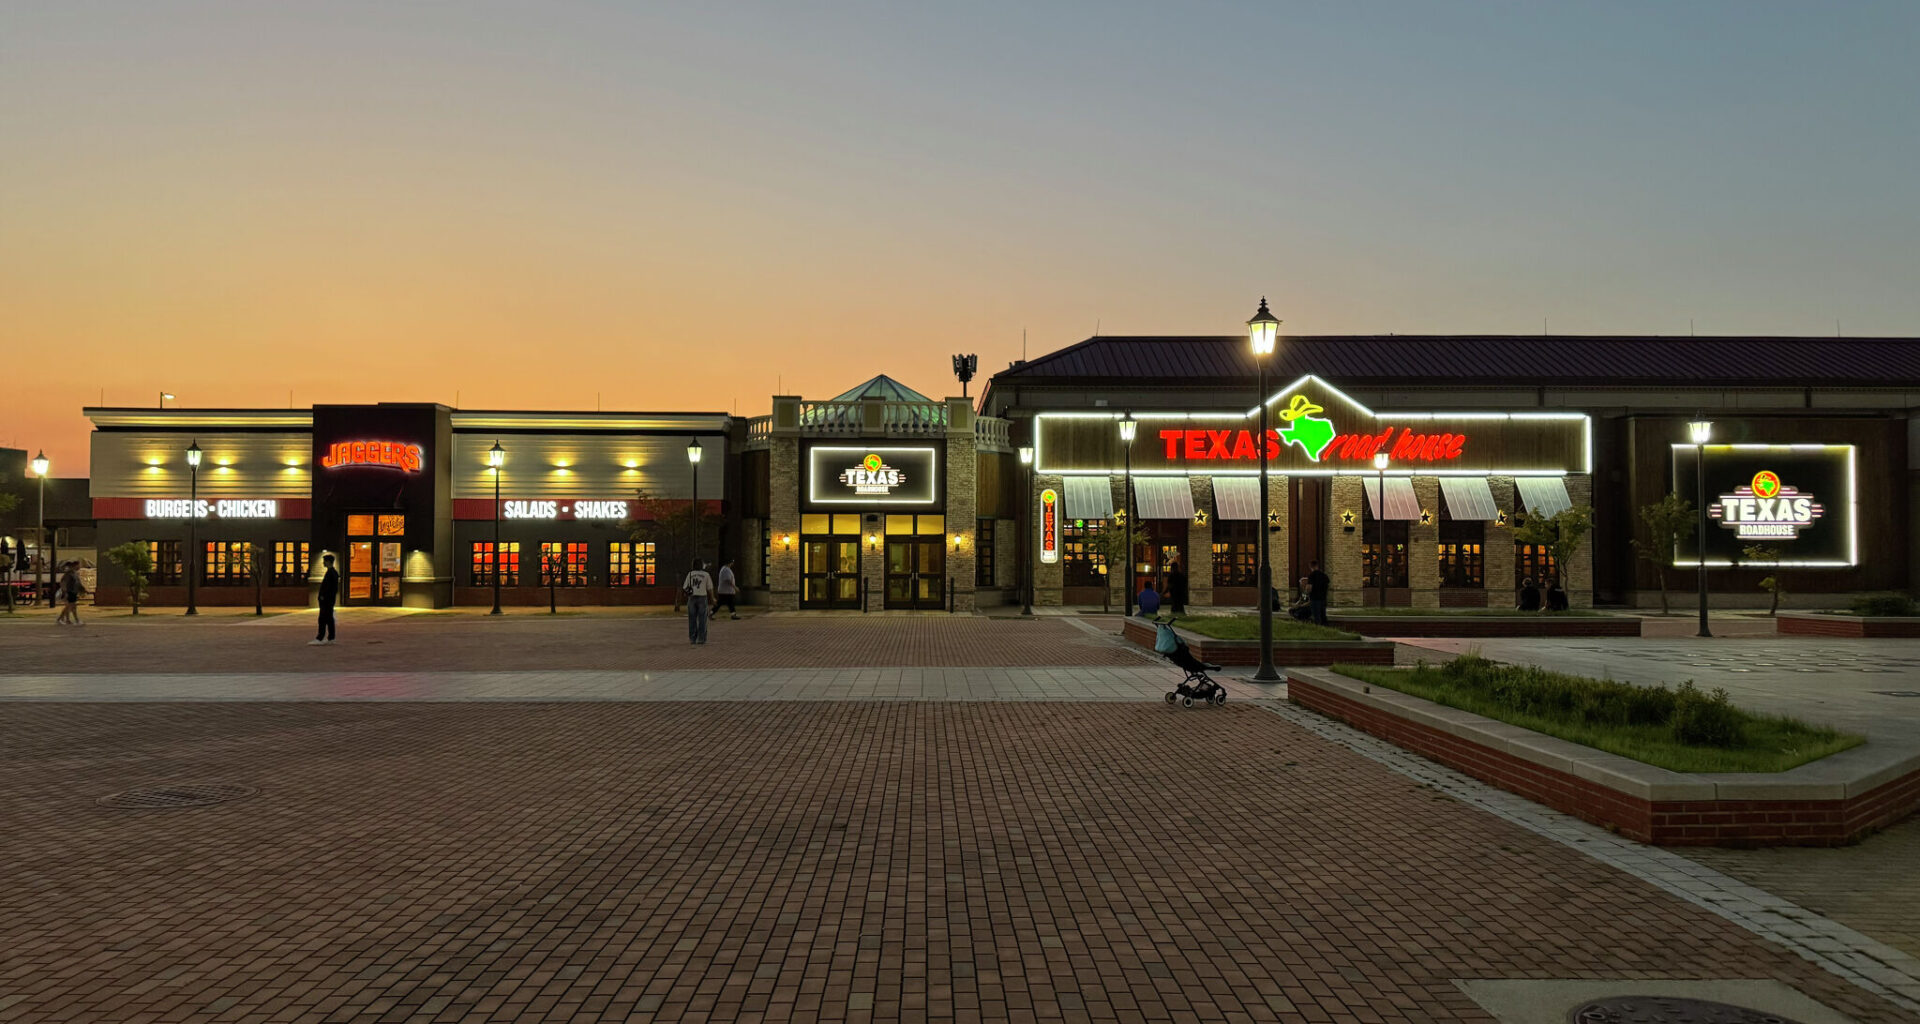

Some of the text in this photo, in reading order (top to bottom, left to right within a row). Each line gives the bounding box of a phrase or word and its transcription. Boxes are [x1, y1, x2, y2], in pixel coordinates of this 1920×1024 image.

[1160, 426, 1466, 462] TEXAS road house
[322, 441, 421, 472] JAGGERS
[845, 470, 899, 485] TEXAS
[146, 500, 276, 517] BURGERS CHICKEN
[504, 501, 627, 518] SALADS SHAKES
[1721, 499, 1811, 521] TEXAS
[1045, 503, 1054, 551] TEXAS
[1739, 525, 1795, 535] ROADHOUSE
